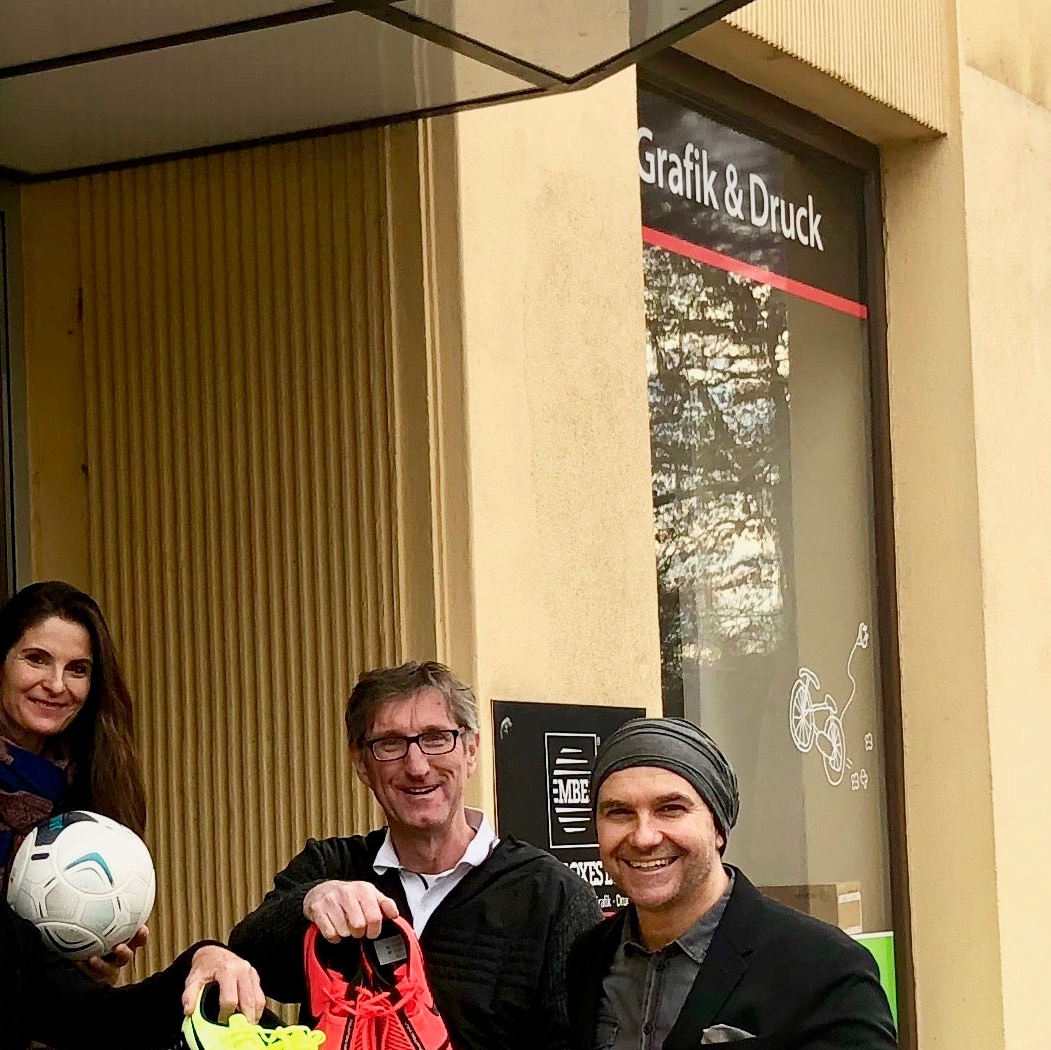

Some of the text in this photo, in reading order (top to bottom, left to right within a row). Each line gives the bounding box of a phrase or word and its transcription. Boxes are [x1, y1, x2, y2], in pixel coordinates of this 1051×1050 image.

[636, 126, 824, 252] Grafik & Druck
[557, 778, 591, 805] MBE
[563, 860, 604, 887] XES
